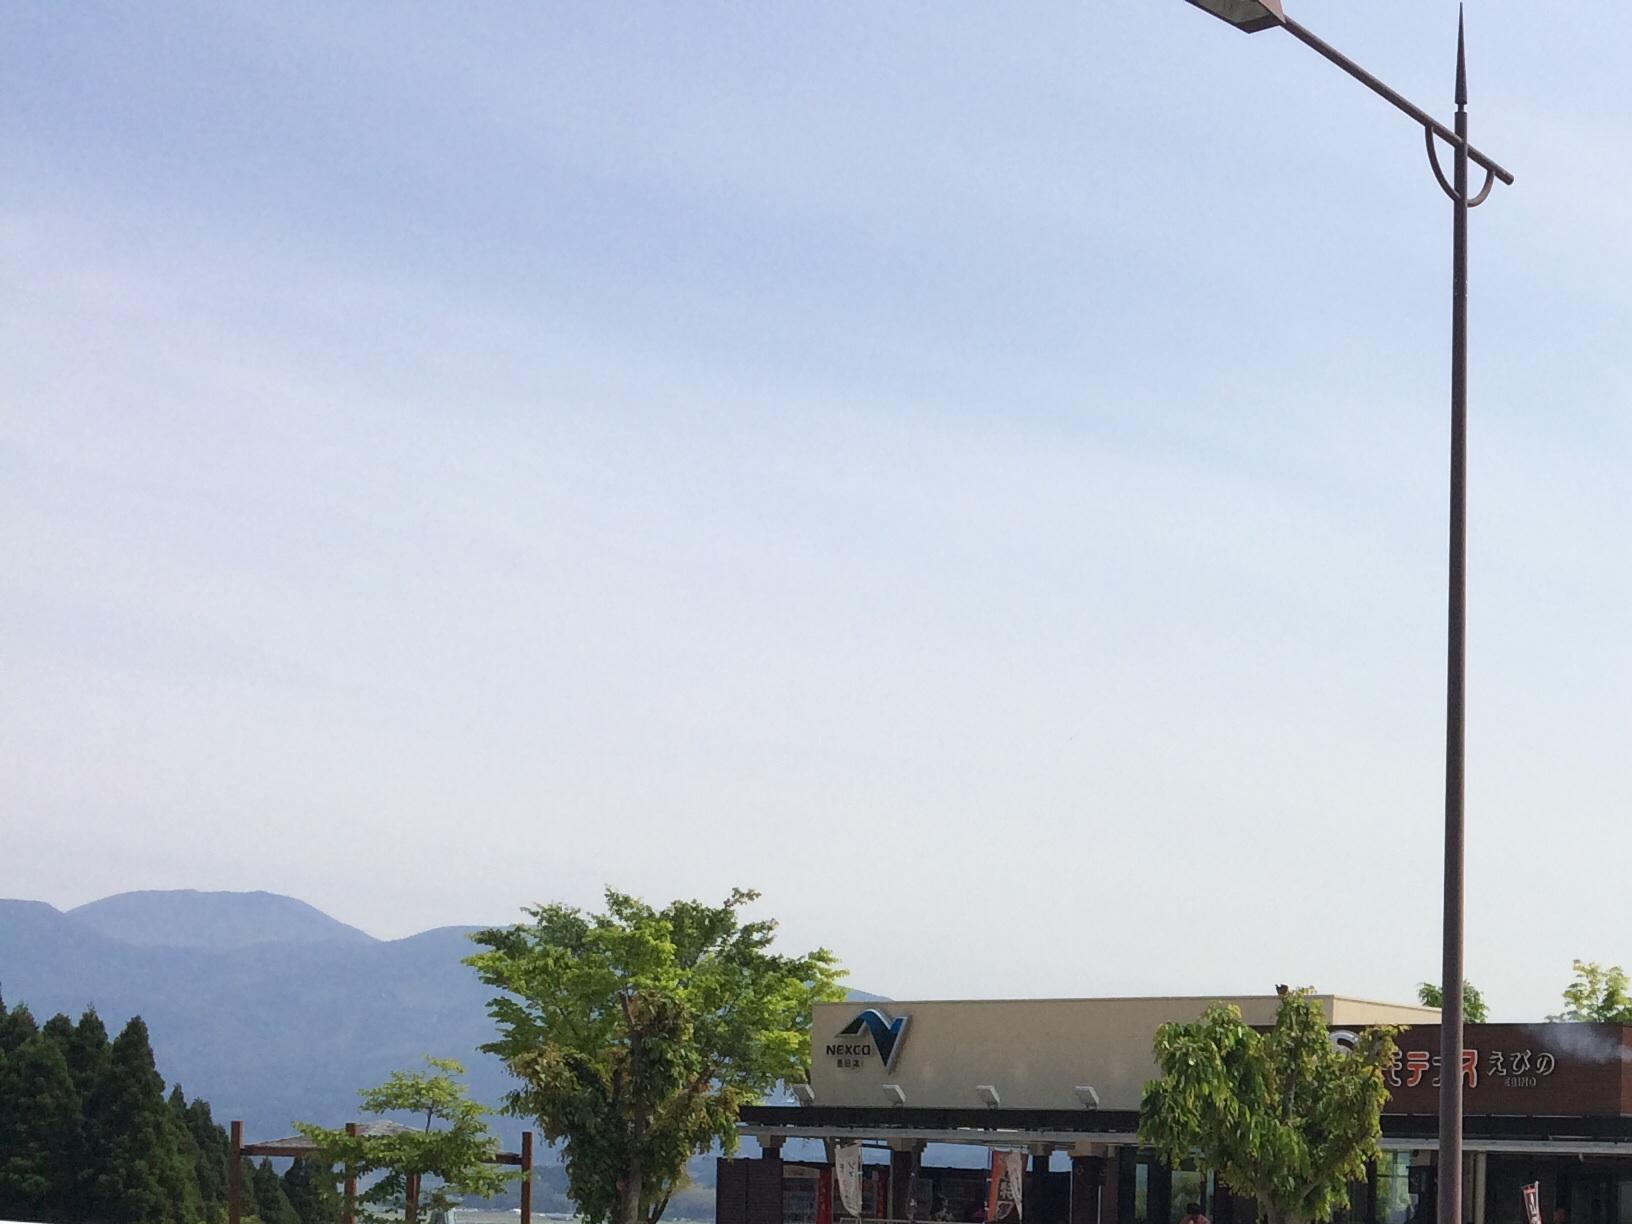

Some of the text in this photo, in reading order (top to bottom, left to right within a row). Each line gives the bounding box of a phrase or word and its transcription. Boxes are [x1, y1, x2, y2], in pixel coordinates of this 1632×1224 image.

[826, 1044, 871, 1056] NEXCO
[1487, 1048, 1556, 1077] えびの
